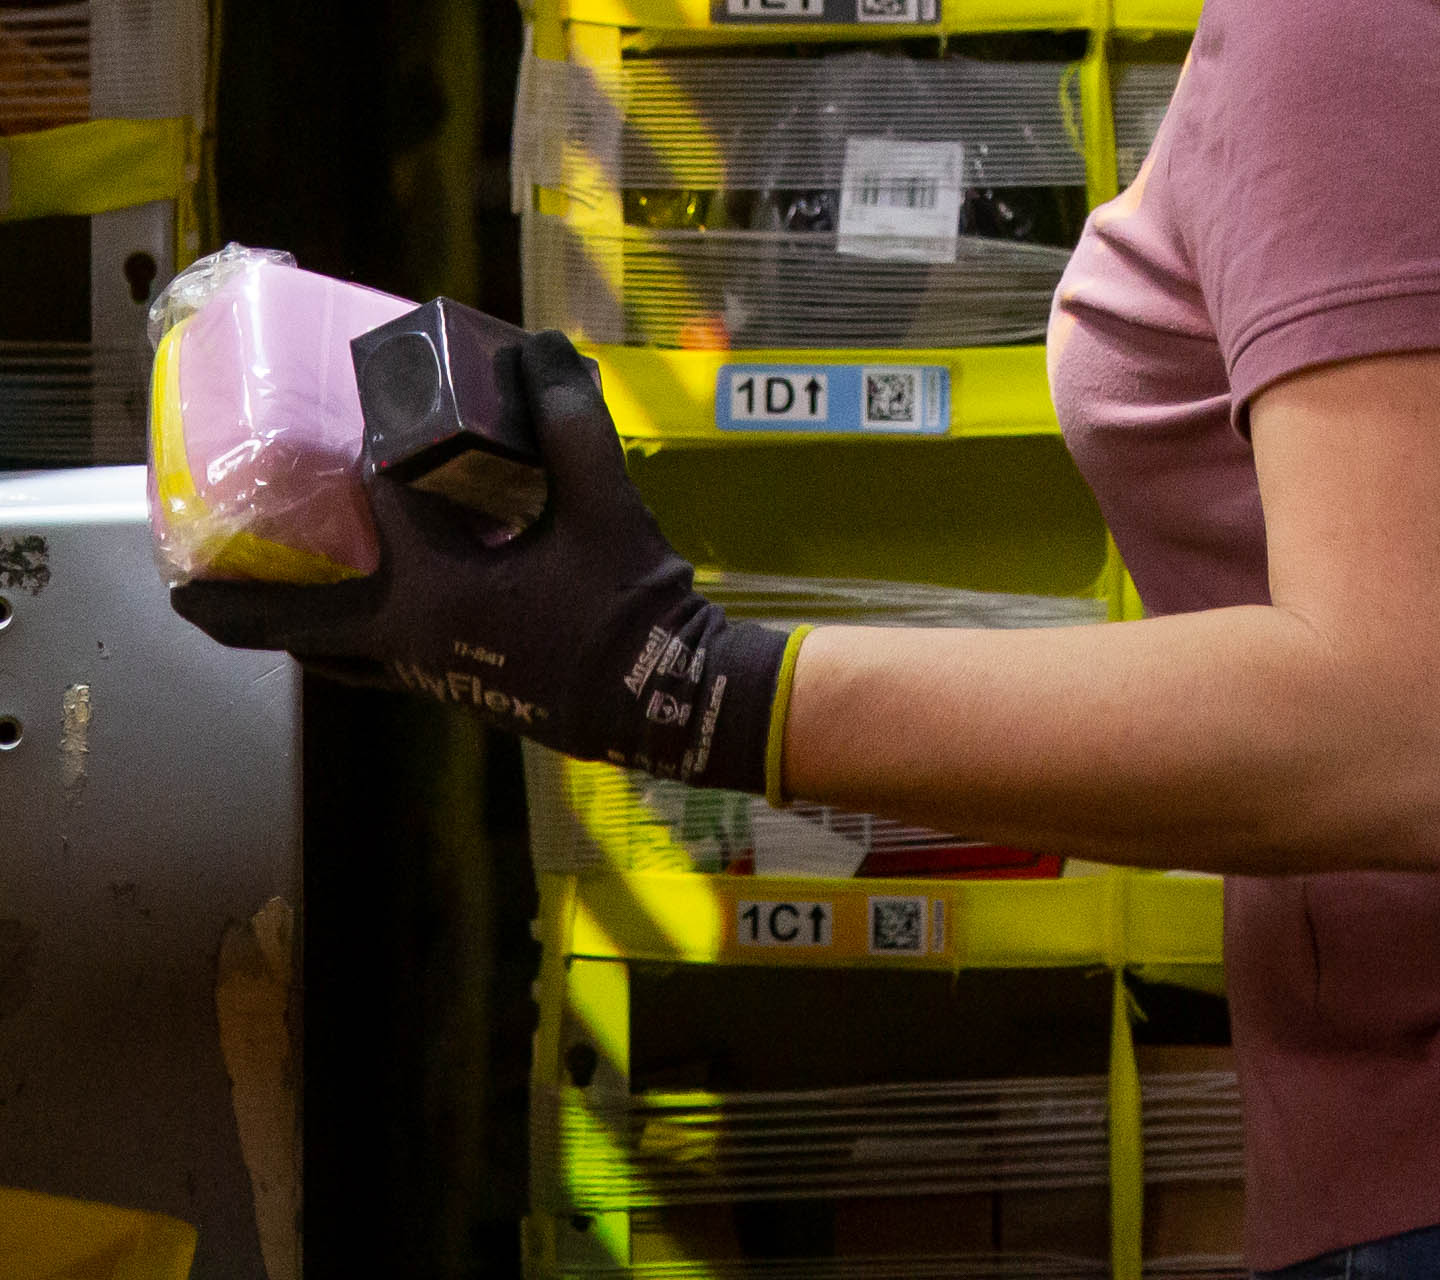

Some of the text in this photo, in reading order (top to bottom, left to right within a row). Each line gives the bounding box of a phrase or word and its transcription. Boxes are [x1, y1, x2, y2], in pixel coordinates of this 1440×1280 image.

[738, 376, 795, 415] 1D
[623, 624, 671, 696] Ansell
[742, 903, 800, 943] 1C
